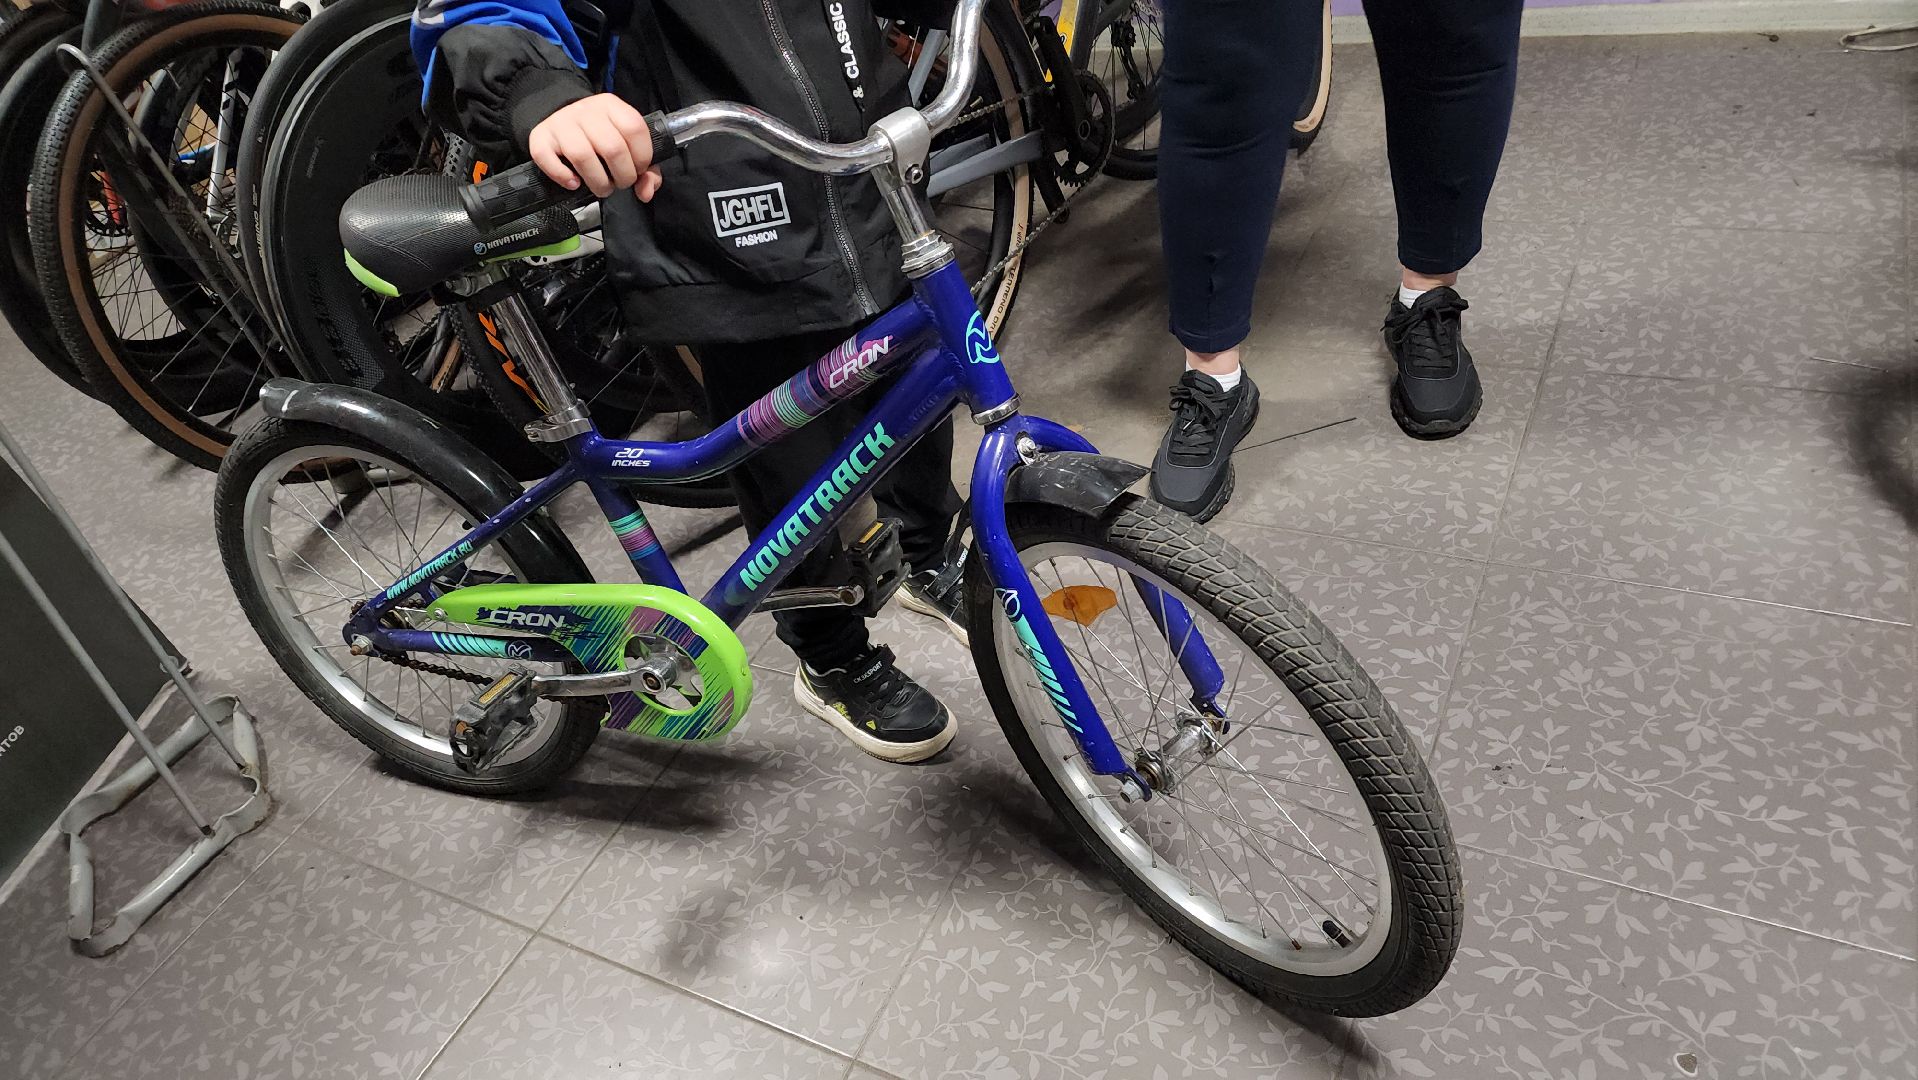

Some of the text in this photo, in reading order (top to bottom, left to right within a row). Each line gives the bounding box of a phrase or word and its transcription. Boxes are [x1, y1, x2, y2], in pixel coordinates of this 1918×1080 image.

[830, 2, 864, 98] & CLASSIC
[720, 194, 783, 228] JGHFL
[487, 228, 539, 249] NOVATRACK
[735, 230, 778, 247] FASHION
[829, 335, 889, 389] CRON
[615, 447, 645, 459] 20
[739, 422, 896, 591] NOVATRACK
[489, 610, 566, 628] CRON
